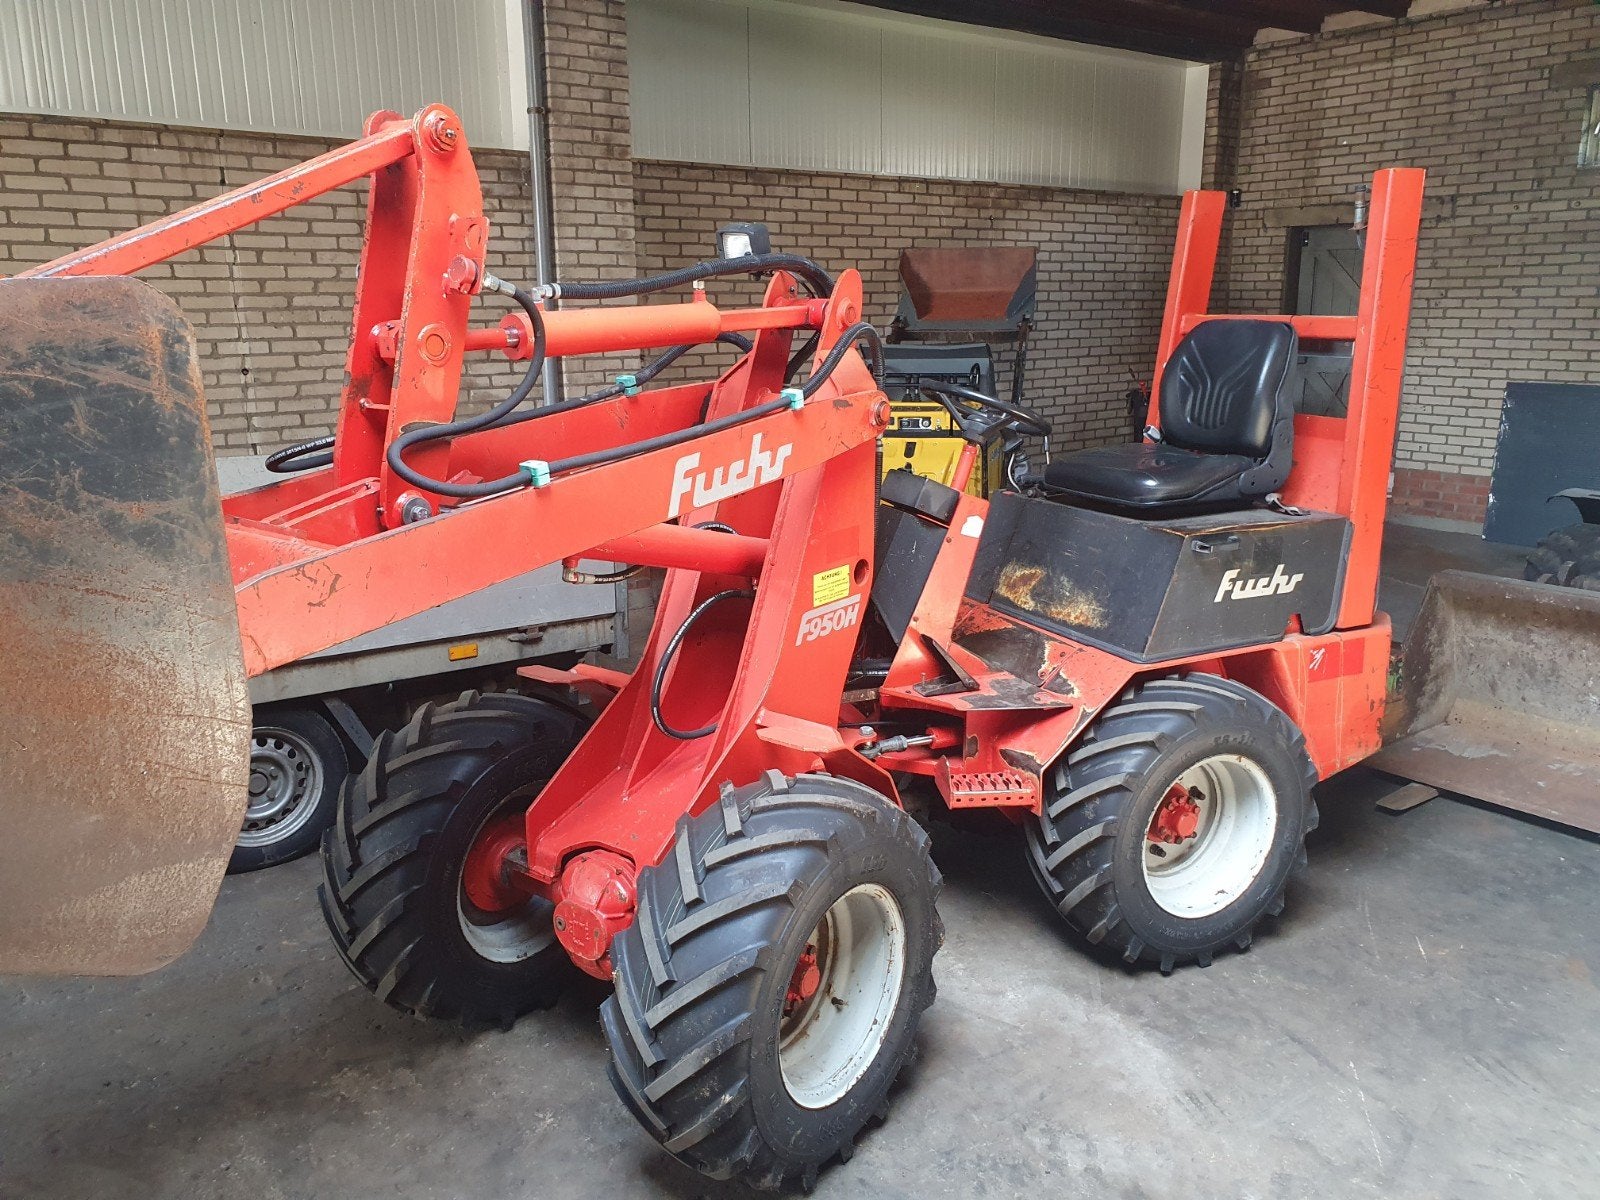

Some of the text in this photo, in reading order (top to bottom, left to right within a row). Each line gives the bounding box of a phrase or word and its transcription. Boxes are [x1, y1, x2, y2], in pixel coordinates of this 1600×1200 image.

[668, 432, 793, 519] Fuchs
[1214, 563, 1305, 603] Fuchs
[795, 593, 862, 647] F950H
